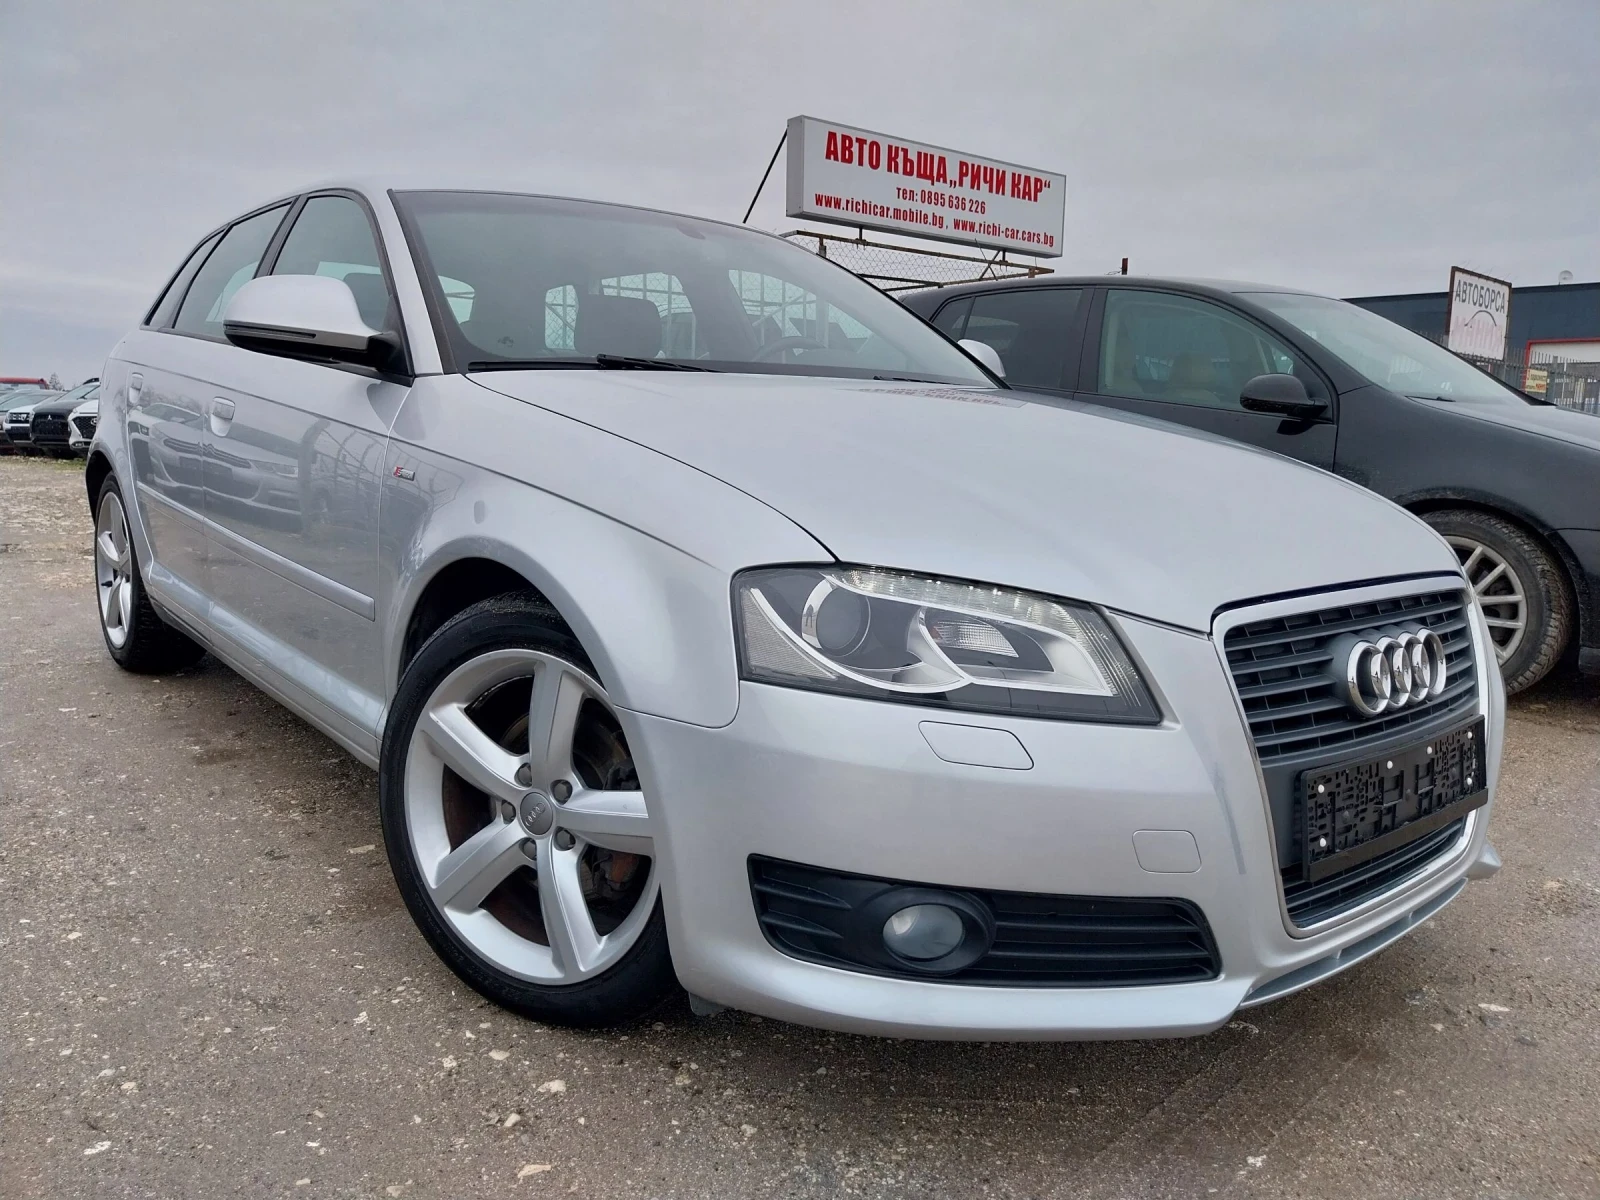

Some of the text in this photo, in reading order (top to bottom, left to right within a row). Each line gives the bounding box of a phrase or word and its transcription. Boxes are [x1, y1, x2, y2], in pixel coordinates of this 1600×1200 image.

[825, 131, 880, 170] АВТО
[887, 144, 947, 186] КЪЩА
[896, 187, 986, 215] тел: 0895 636 226
[954, 218, 1054, 247] www.richi-car.cars.bg
[1455, 280, 1505, 314] АВТОБОРСА
